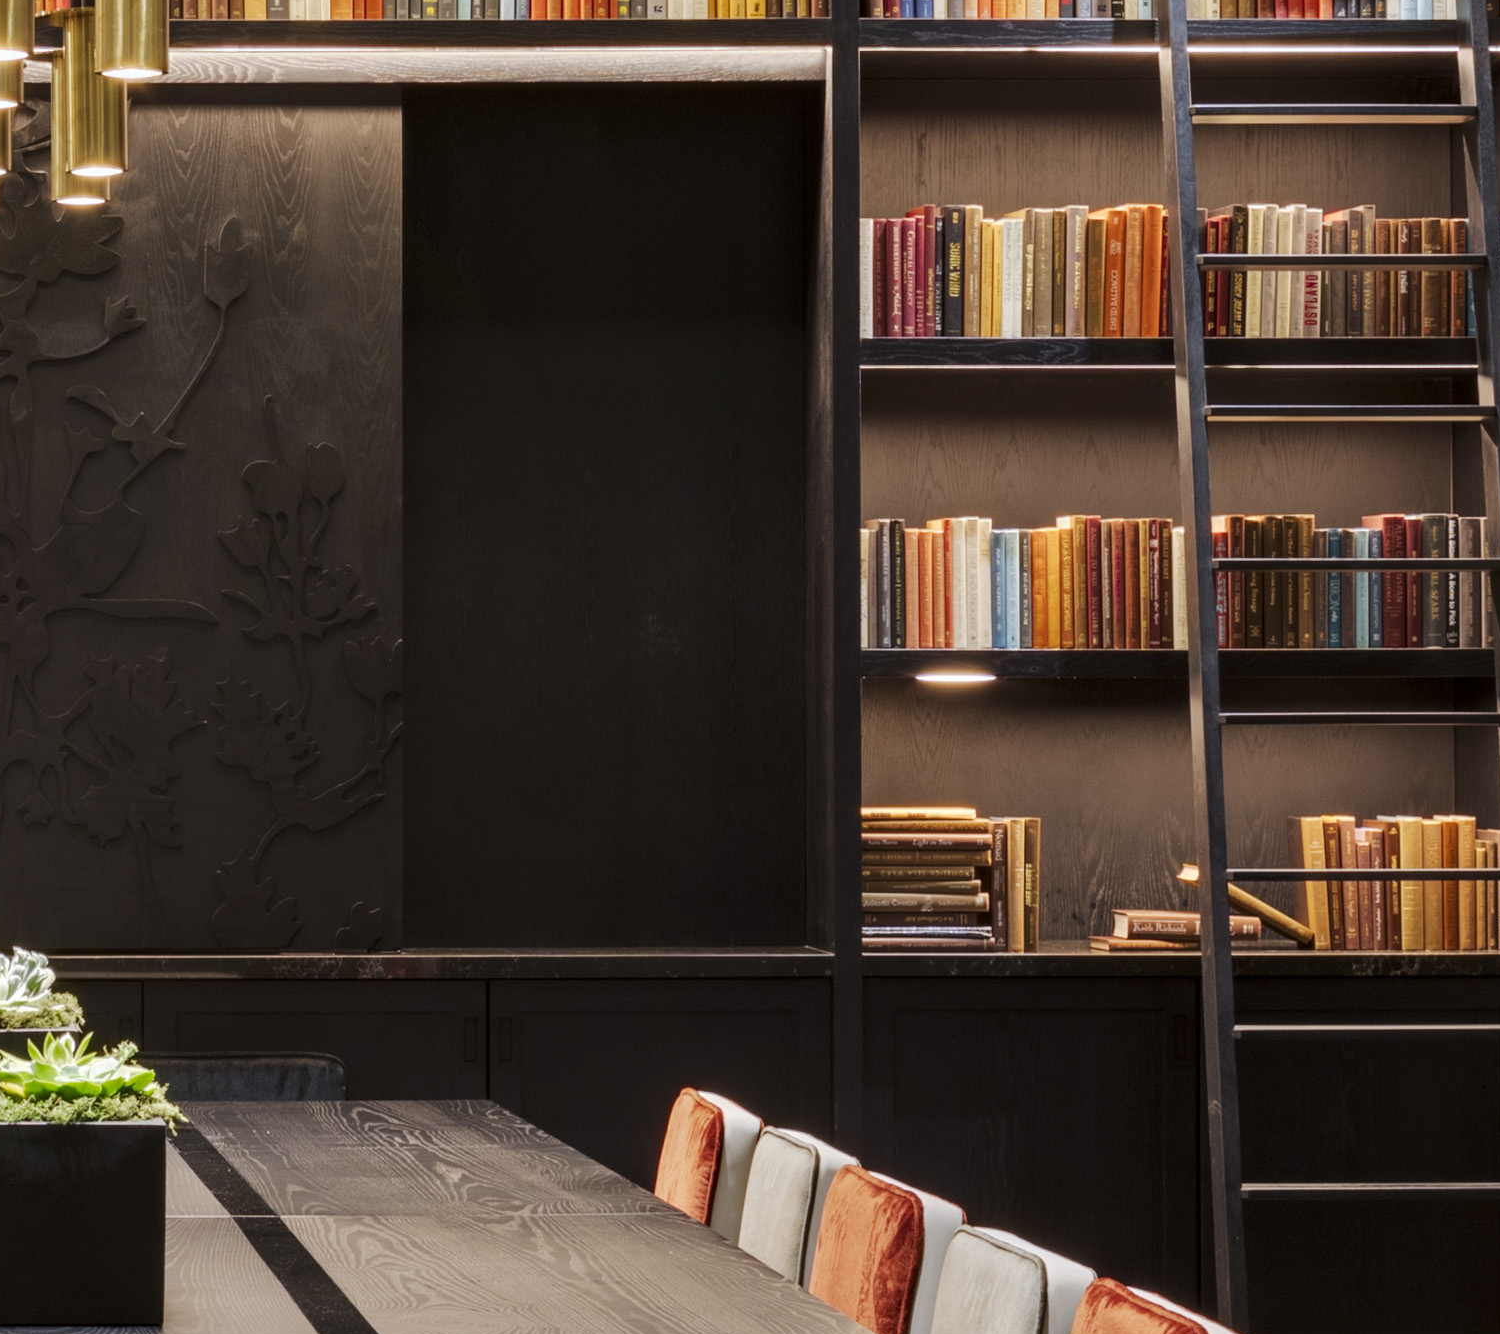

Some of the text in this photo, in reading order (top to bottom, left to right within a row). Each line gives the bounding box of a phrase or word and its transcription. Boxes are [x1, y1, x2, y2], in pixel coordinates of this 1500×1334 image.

[948, 242, 961, 297] SONIC WIND
[1109, 269, 1118, 331] DAVID BALDACCI
[1304, 275, 1319, 326] OSTLAND
[994, 829, 1003, 861] Nomad
[1132, 922, 1187, 933] Keith Richards
